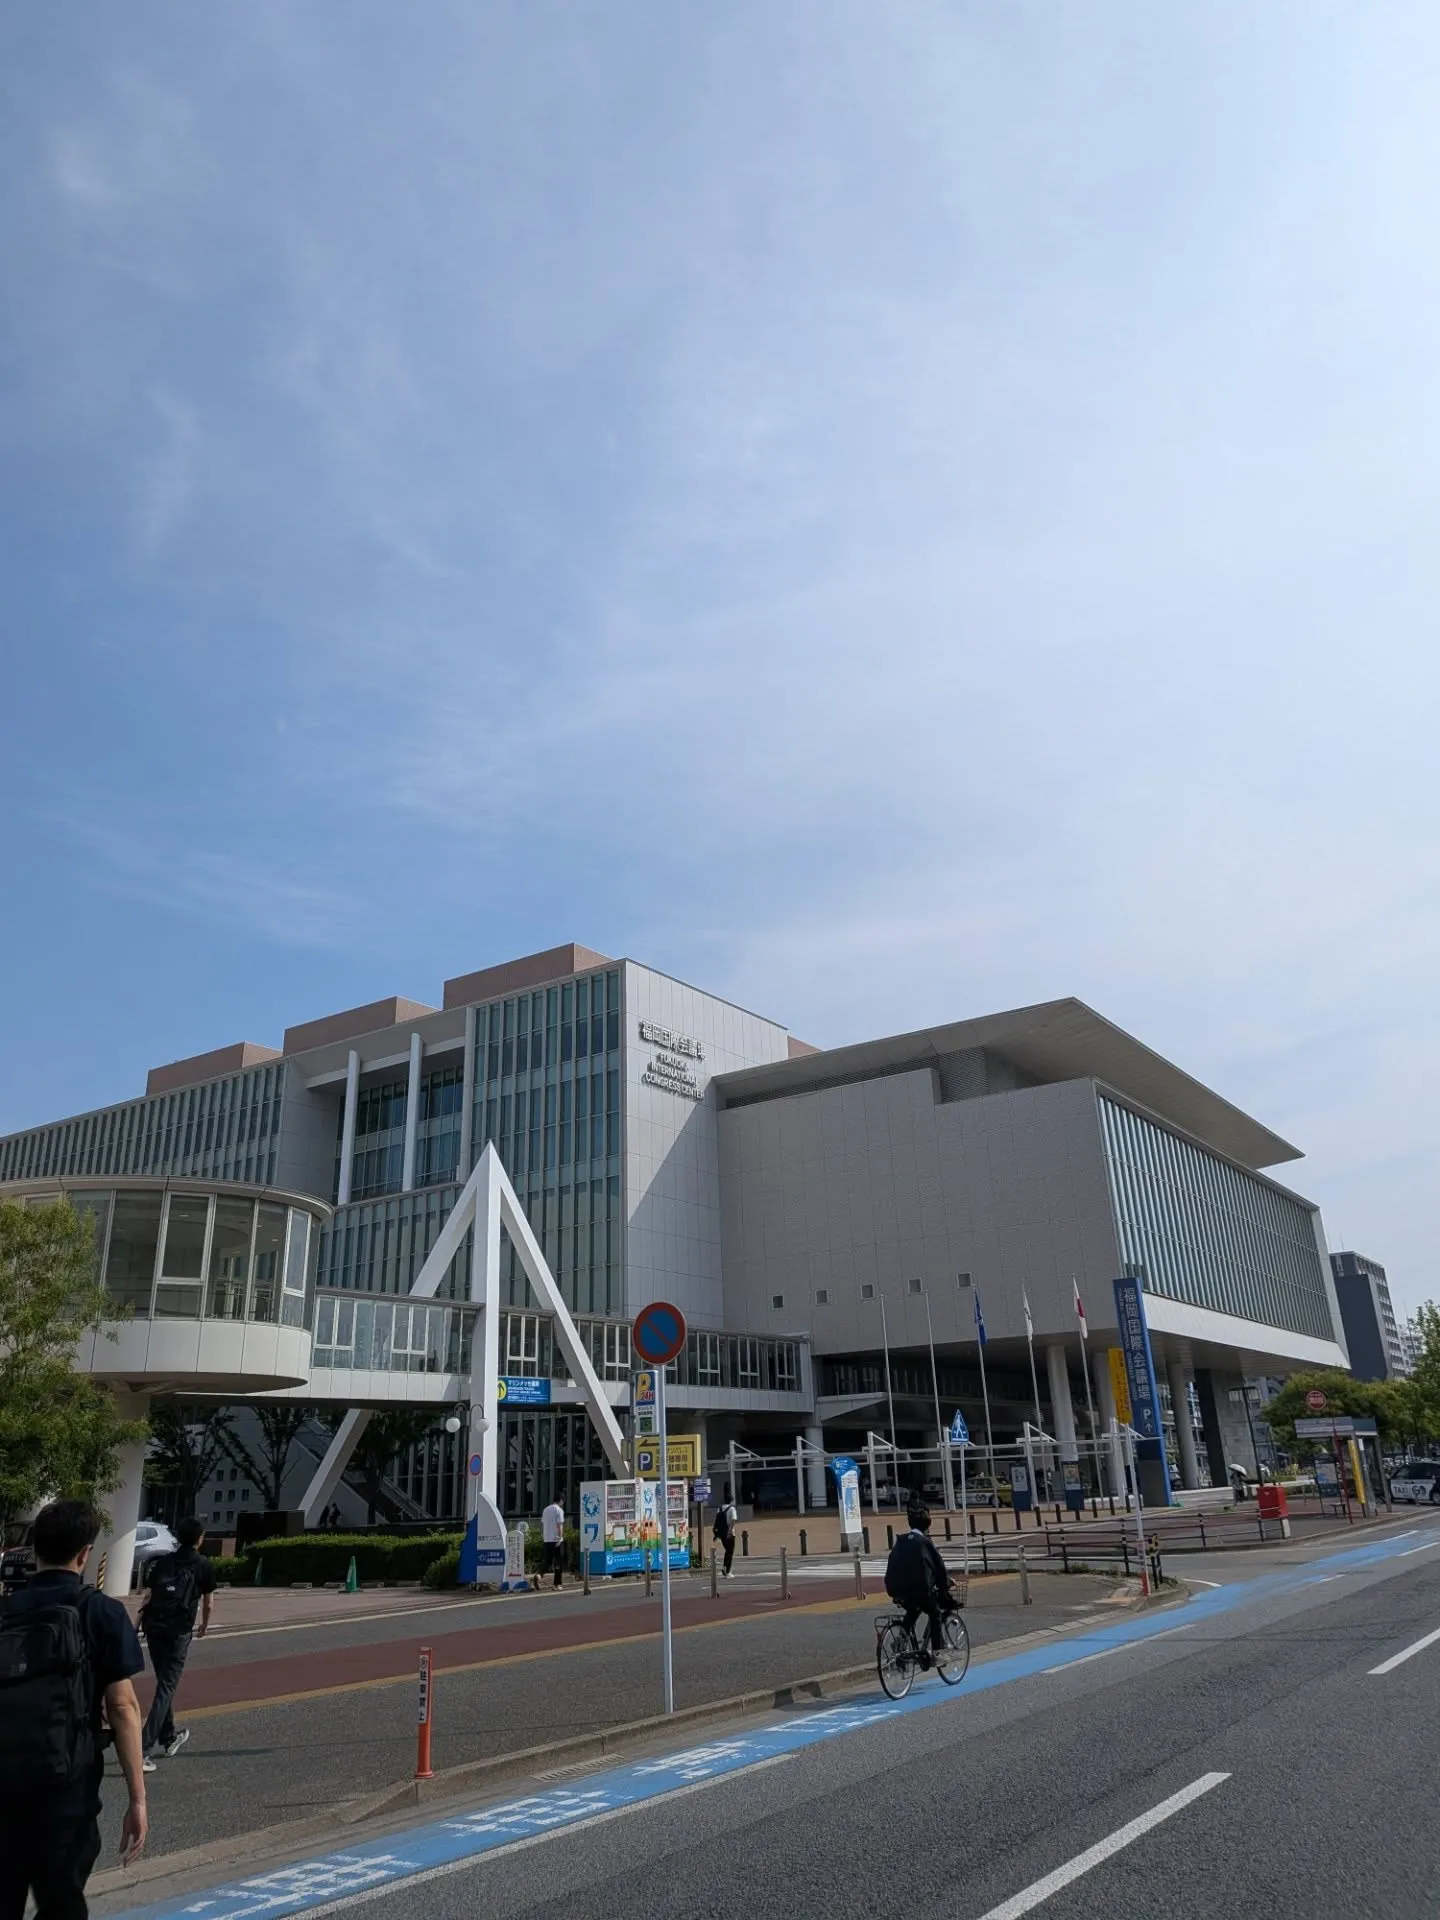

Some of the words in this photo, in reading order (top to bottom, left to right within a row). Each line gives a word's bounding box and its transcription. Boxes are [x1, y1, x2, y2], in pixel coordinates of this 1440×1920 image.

[641, 1020, 706, 1060] 福岡国際会議場
[649, 1062, 698, 1086] INTERNATIONAL
[659, 1053, 689, 1071] FUKUOKA
[644, 1071, 681, 1092] CONGRESS
[681, 1084, 704, 1099] CENTER
[1124, 1287, 1151, 1401] 福岡国際会議場
